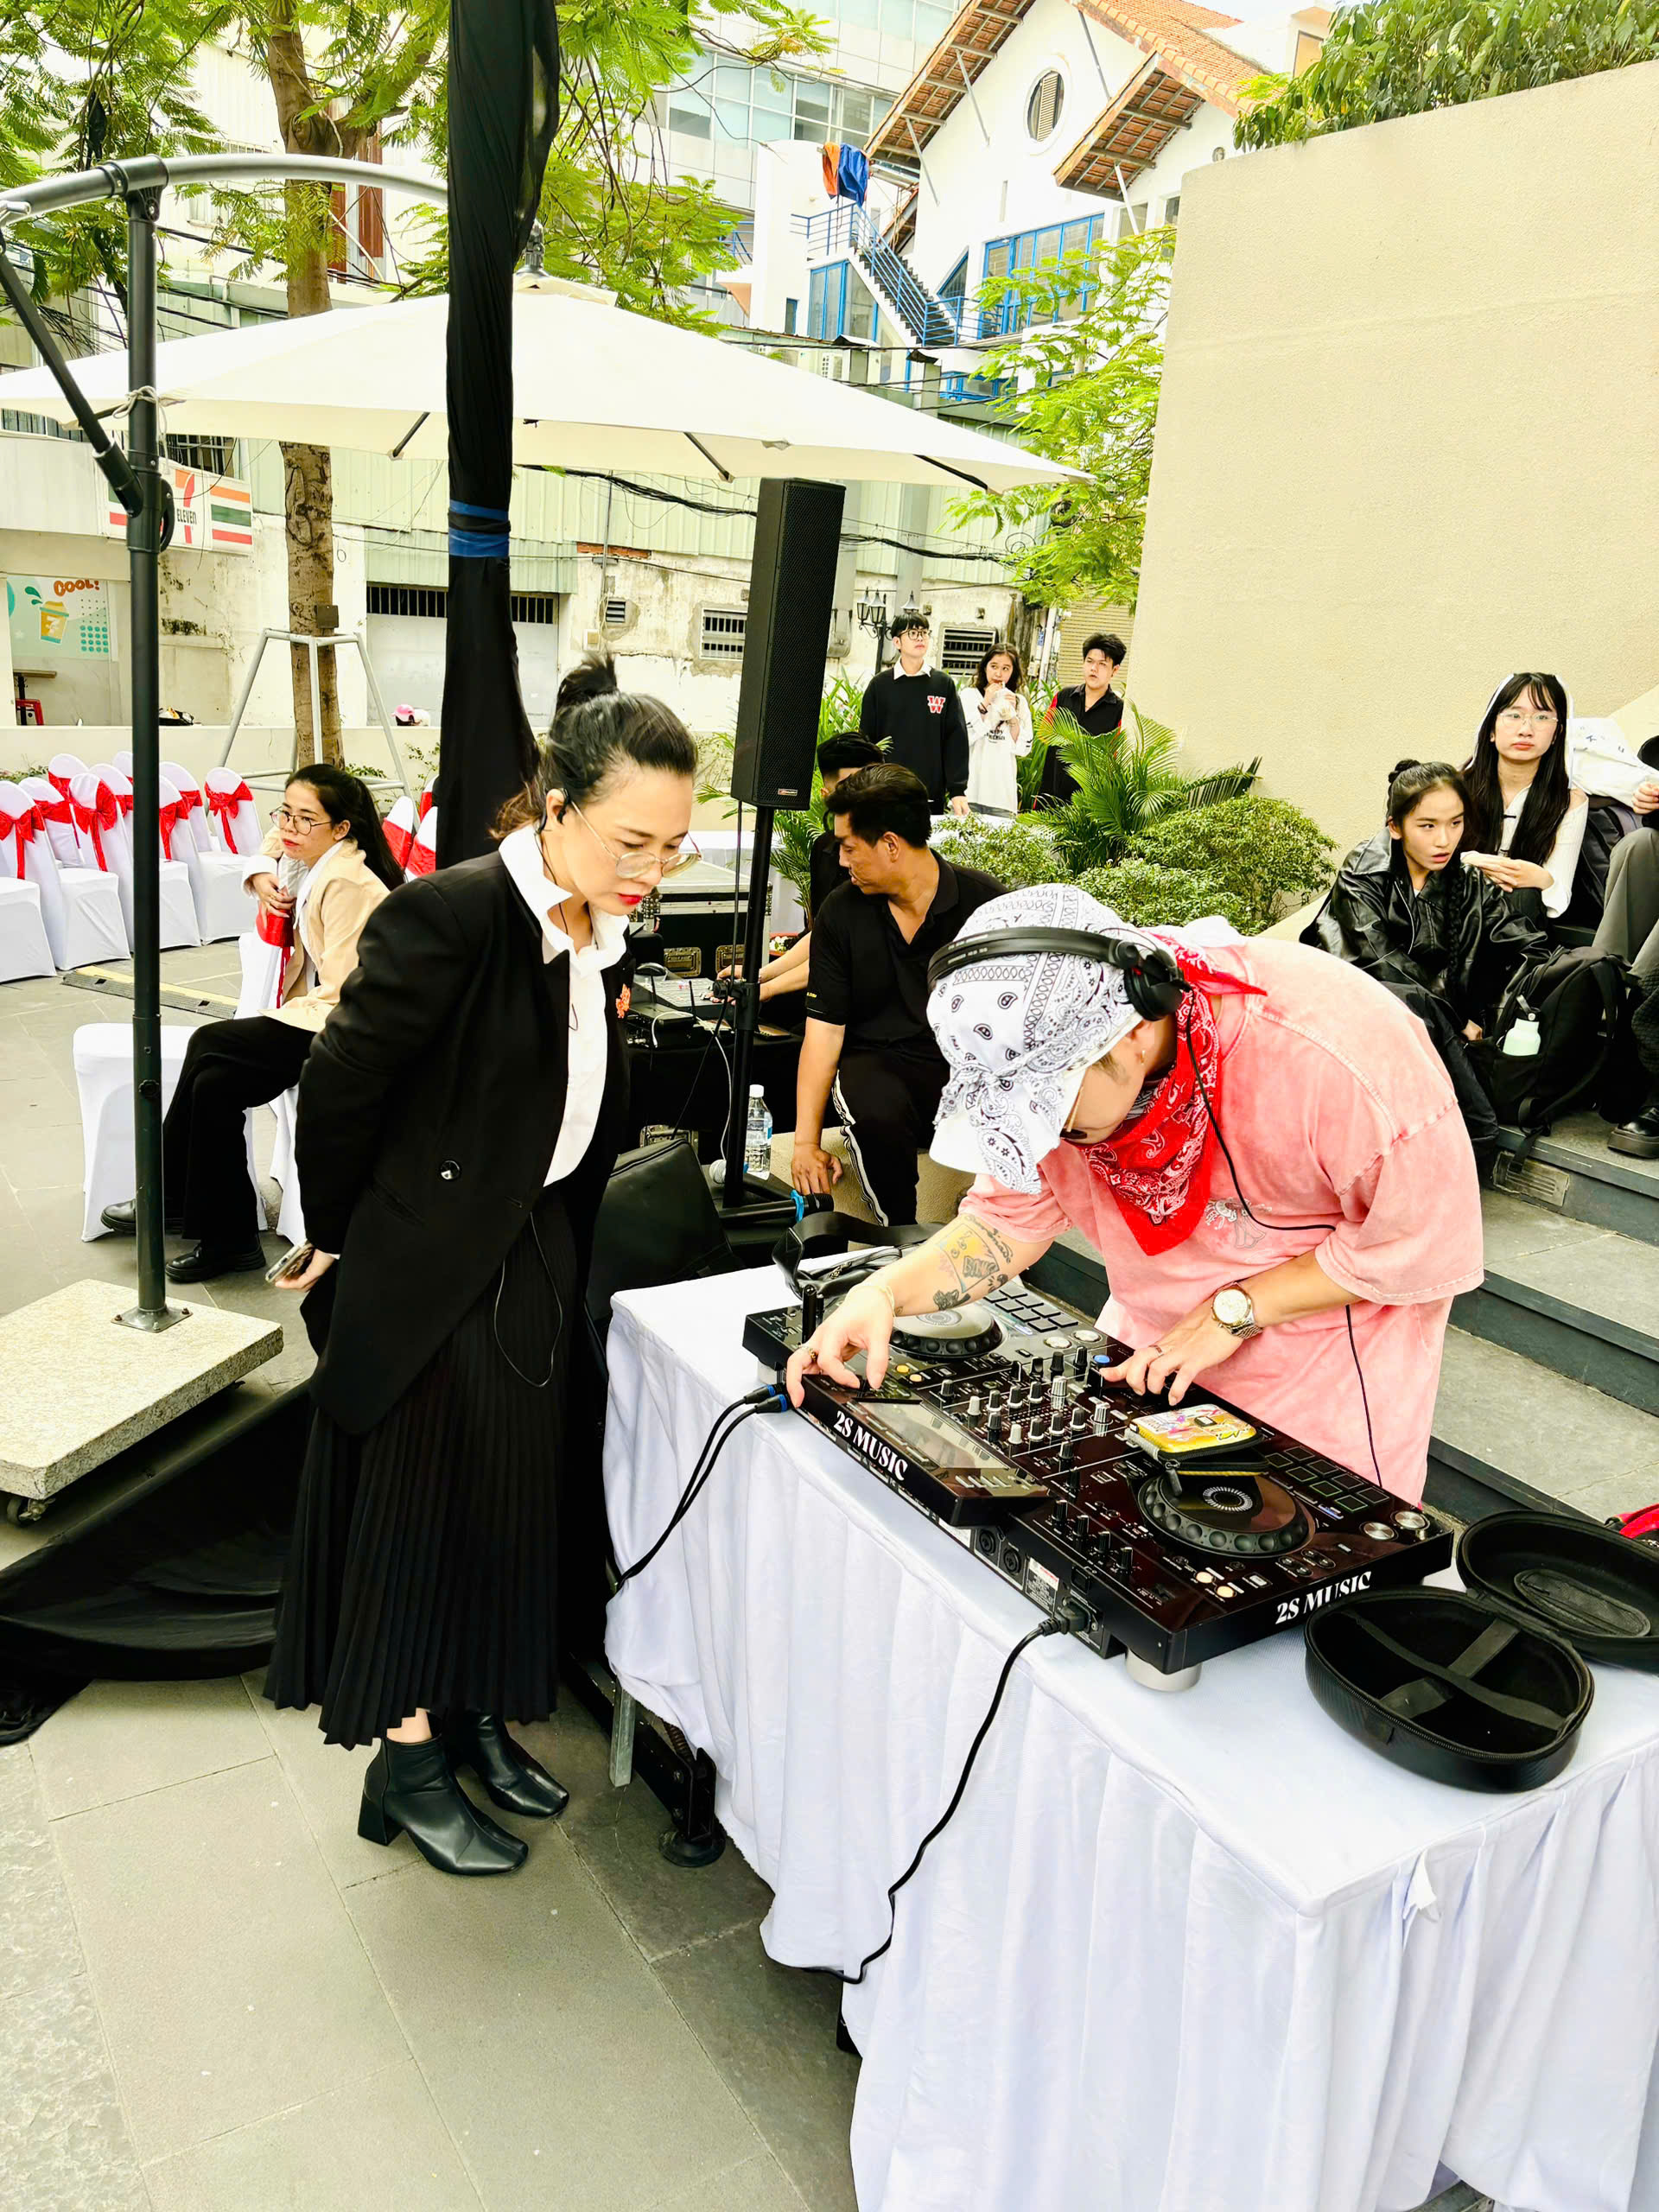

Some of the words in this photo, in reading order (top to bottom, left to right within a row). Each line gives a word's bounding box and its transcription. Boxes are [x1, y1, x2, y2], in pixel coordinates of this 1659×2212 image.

[53, 579, 100, 596] COOL!
[927, 696, 946, 714] W
[833, 1410, 854, 1438] 2S
[853, 1425, 908, 1481] MUSIC
[1274, 1598, 1300, 1624] 2S
[1303, 1571, 1372, 1614] MUSIC
